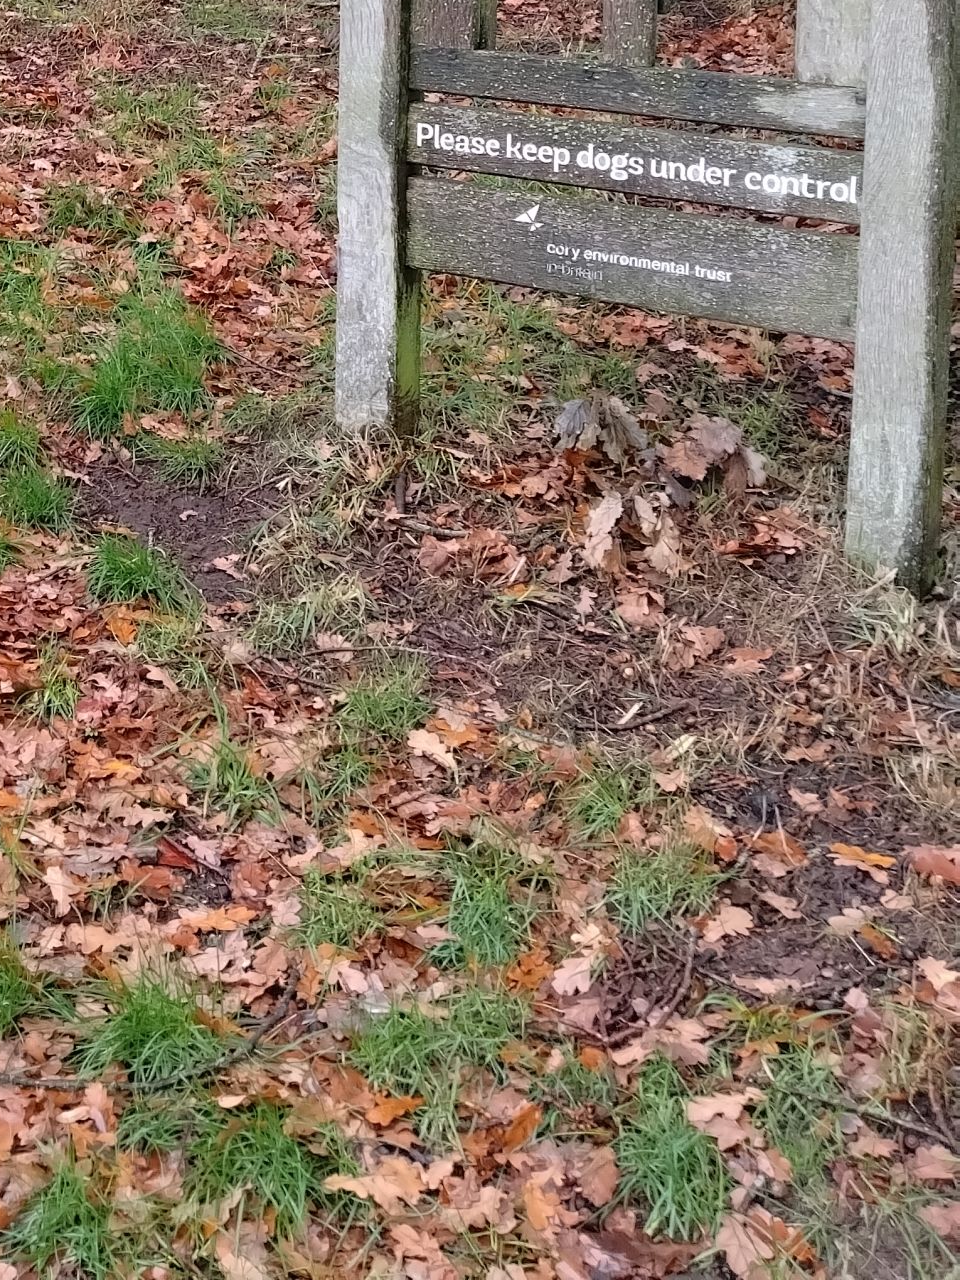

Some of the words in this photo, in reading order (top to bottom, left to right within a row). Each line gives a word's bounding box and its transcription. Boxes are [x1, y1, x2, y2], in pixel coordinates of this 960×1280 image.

[416, 122, 500, 157] Please
[506, 133, 571, 172] keep
[576, 144, 644, 181] dogs
[651, 157, 737, 187] under
[745, 167, 858, 205] control
[546, 243, 580, 259] cory
[583, 249, 690, 276] environmental
